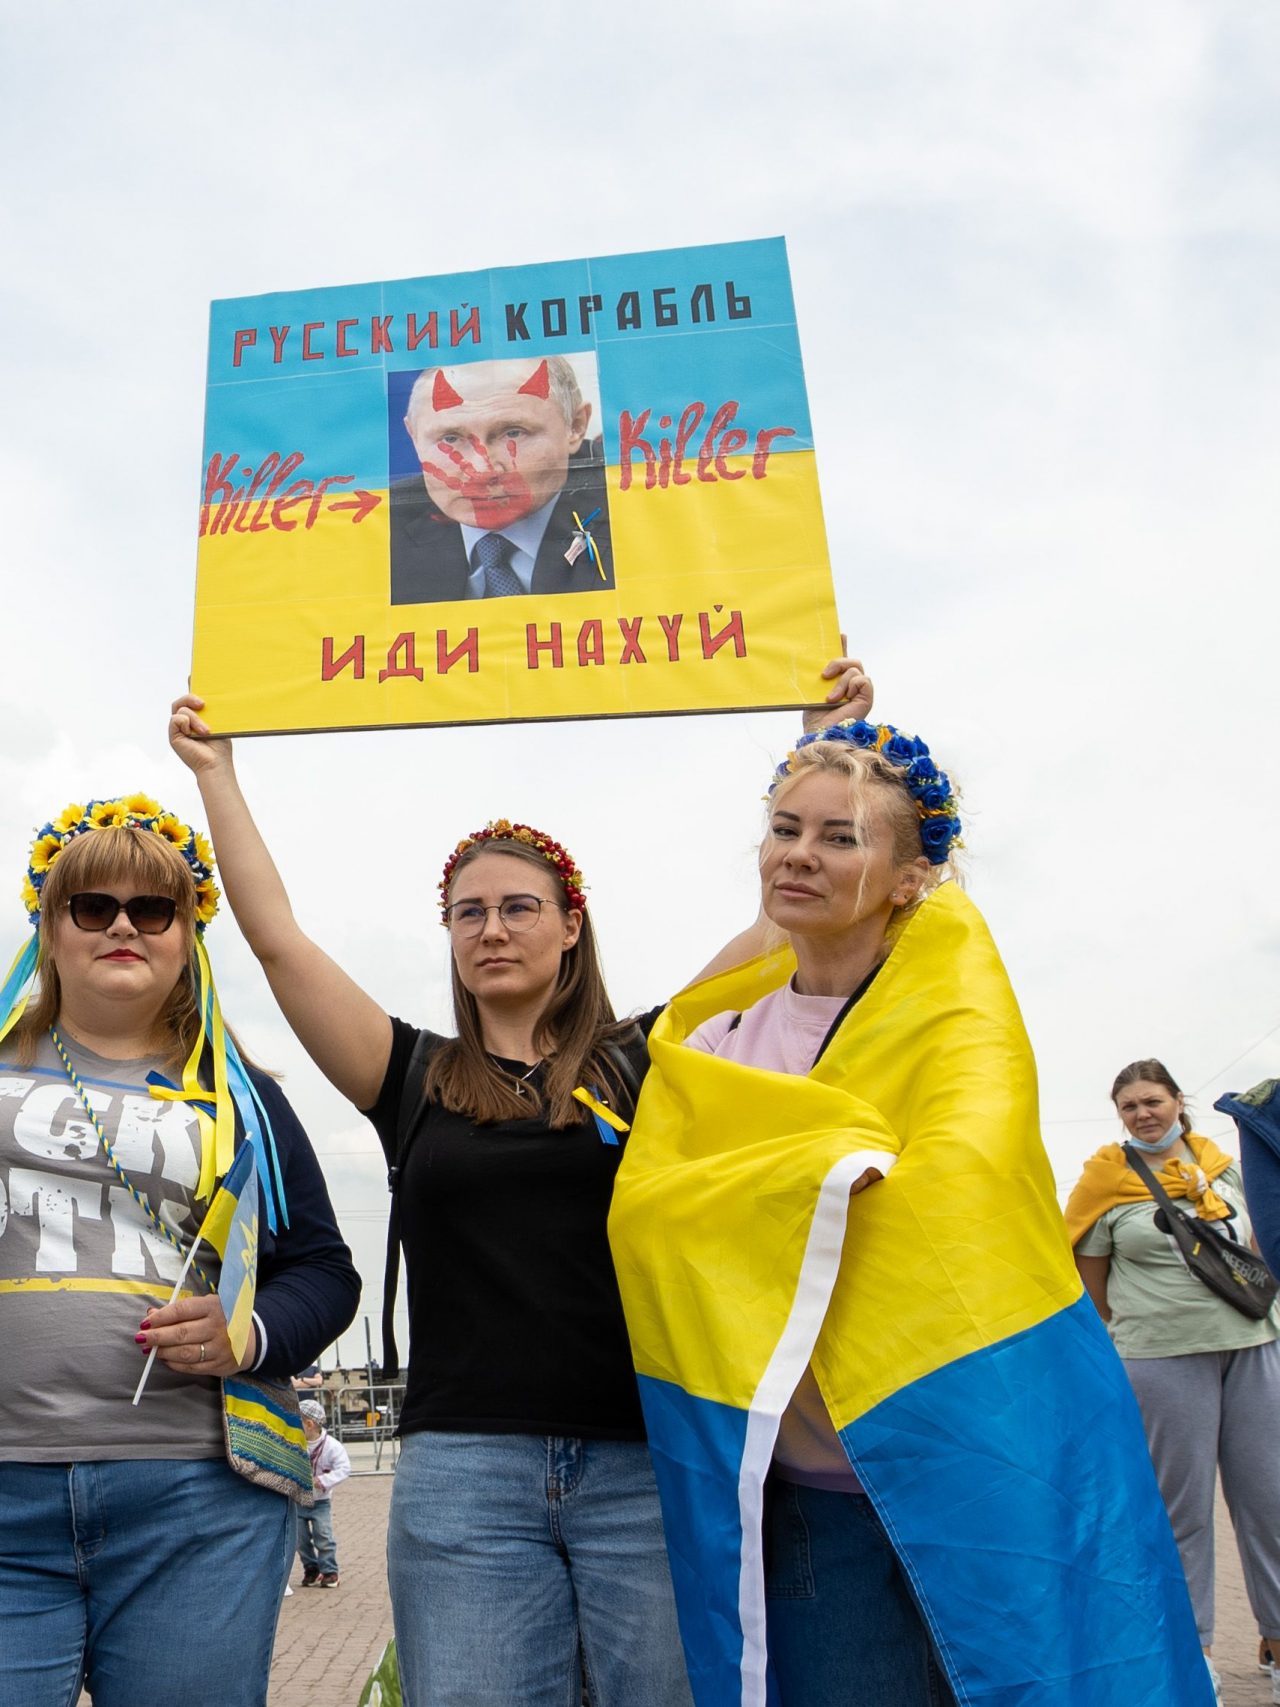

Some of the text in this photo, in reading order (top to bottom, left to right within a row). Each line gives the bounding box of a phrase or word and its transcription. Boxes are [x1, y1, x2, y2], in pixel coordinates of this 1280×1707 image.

[232, 281, 753, 368] РУССКИЙ КОРАБЛЬ
[619, 400, 797, 491] Killer
[199, 451, 356, 537] Killer
[321, 604, 748, 684] ИДИ НАХУЙ
[1221, 1248, 1270, 1289] REEBOK
